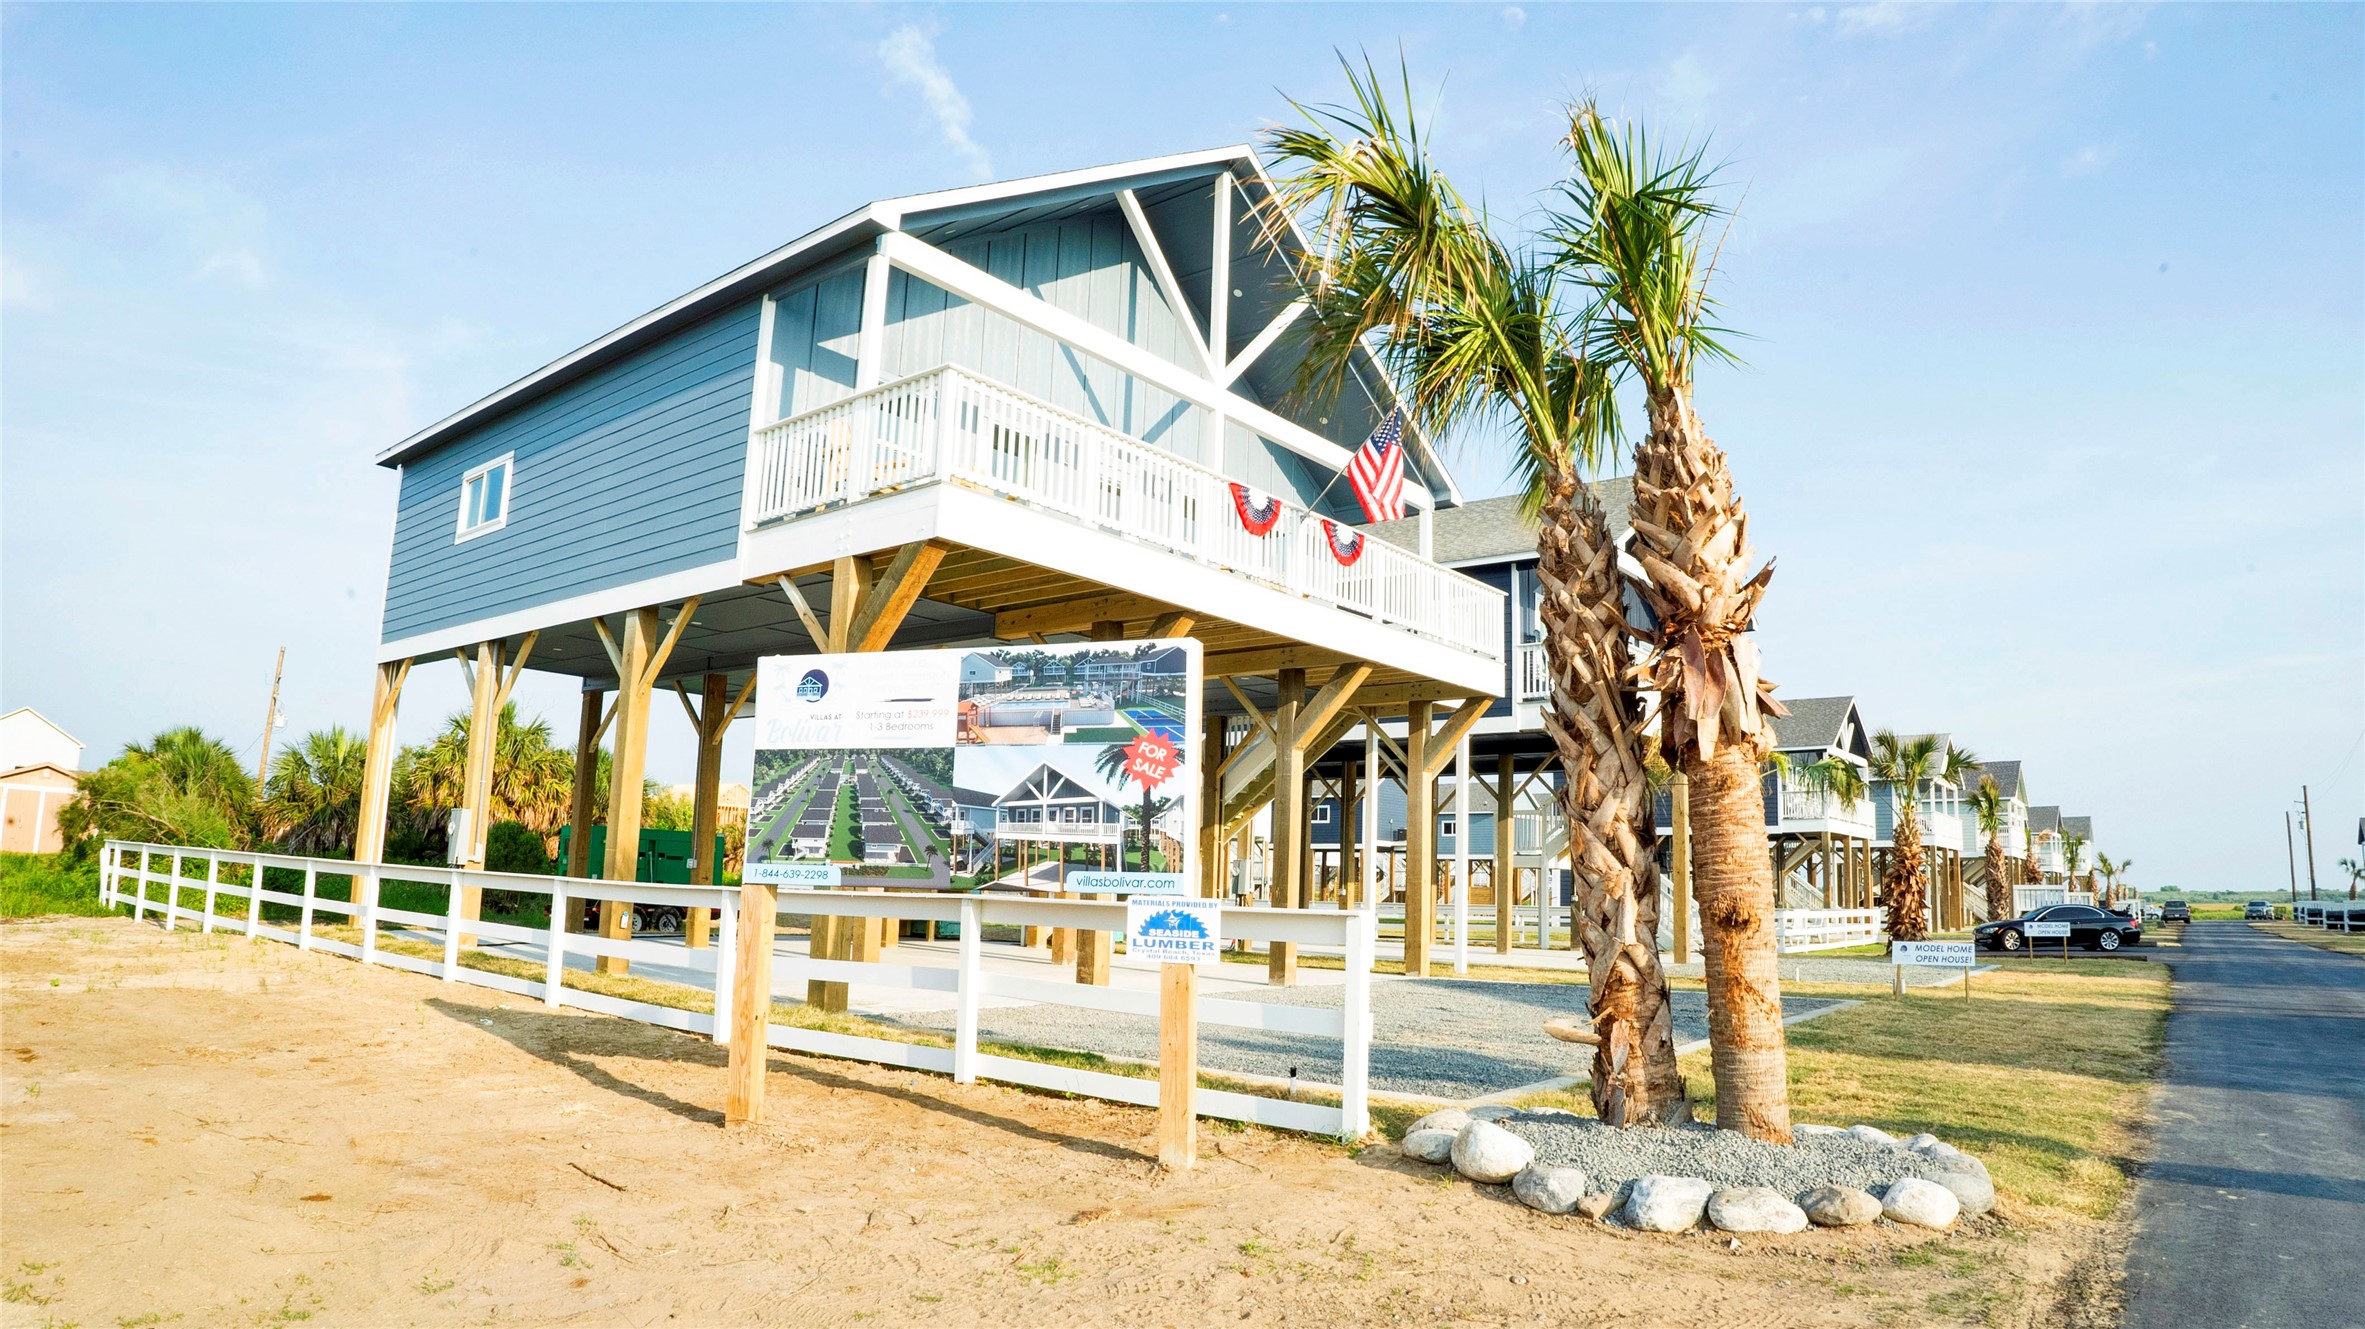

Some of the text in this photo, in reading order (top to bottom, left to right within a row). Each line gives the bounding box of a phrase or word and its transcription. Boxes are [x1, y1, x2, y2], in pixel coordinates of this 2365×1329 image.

[810, 713, 832, 721] VILLAS
[856, 710, 891, 720] Starting
[894, 711, 904, 719] at
[767, 717, 843, 744] Bolivar
[869, 722, 934, 731] 1-3 Bedrooms
[1137, 741, 1168, 763] FOR
[1132, 758, 1166, 780] SALE
[754, 868, 829, 880] 1-844-639-2298
[1076, 875, 1176, 889] villasbolivar.com
[1131, 899, 1170, 907] MATERIALS
[1171, 900, 1207, 909] PROVIDED
[1148, 928, 1200, 938] SEASIDE
[1132, 938, 1215, 951] LUMBER
[1914, 944, 1973, 953] MODEL HOME
[1915, 954, 1972, 964] OPEN HOUSE!
